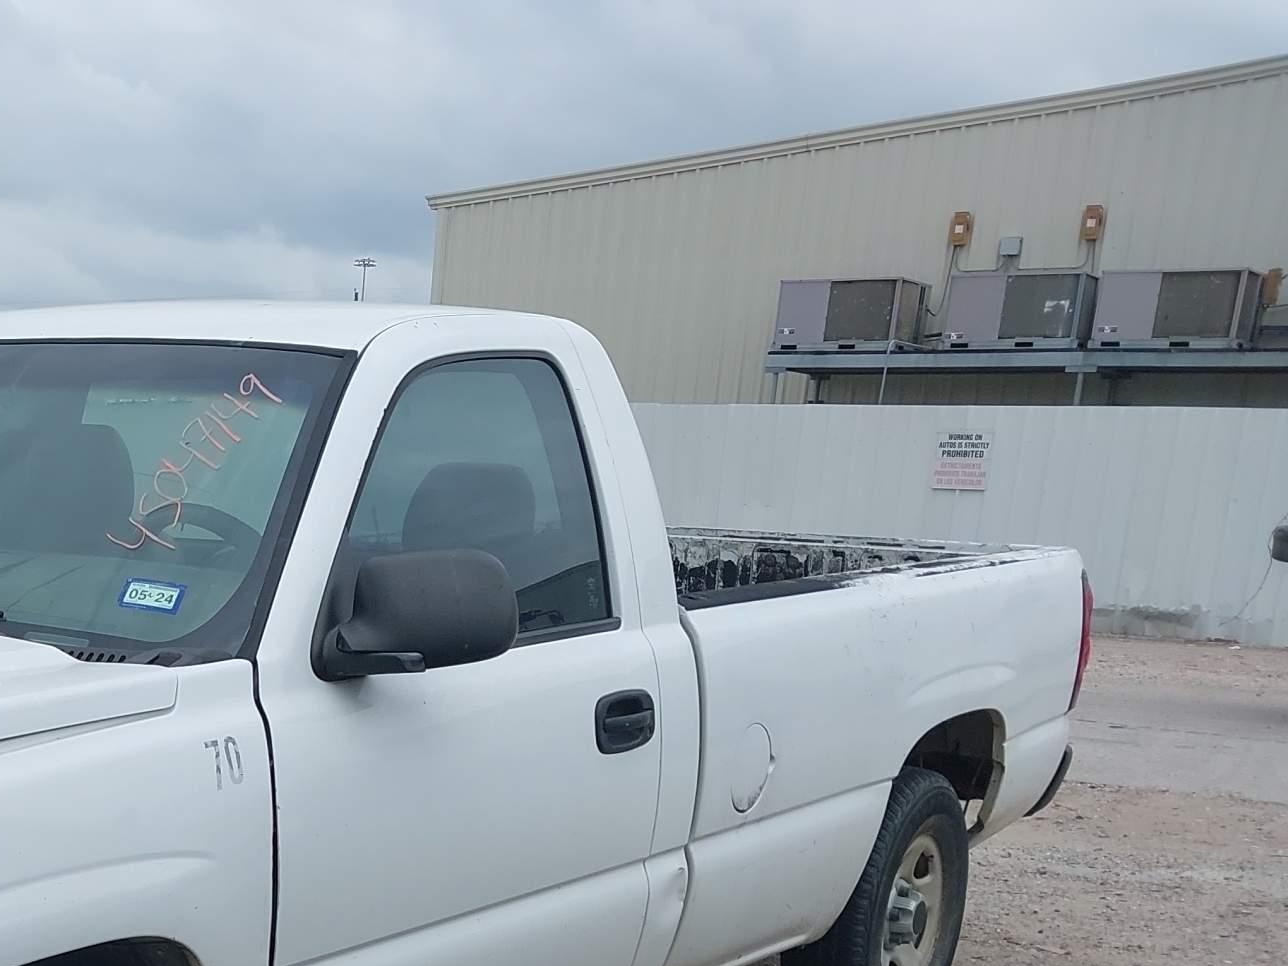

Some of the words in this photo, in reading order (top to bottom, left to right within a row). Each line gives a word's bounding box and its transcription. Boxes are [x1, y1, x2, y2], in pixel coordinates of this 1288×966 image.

[948, 433, 974, 441] WORKING
[975, 433, 983, 441] ON
[938, 441, 957, 449] AUTOS
[957, 441, 963, 449] IS
[964, 441, 990, 449] STRICTLY
[941, 449, 985, 458] PROHIBITED
[105, 373, 283, 550] 45047149
[128, 588, 149, 601] 05
[154, 592, 175, 605] 24
[203, 735, 244, 792] 70
